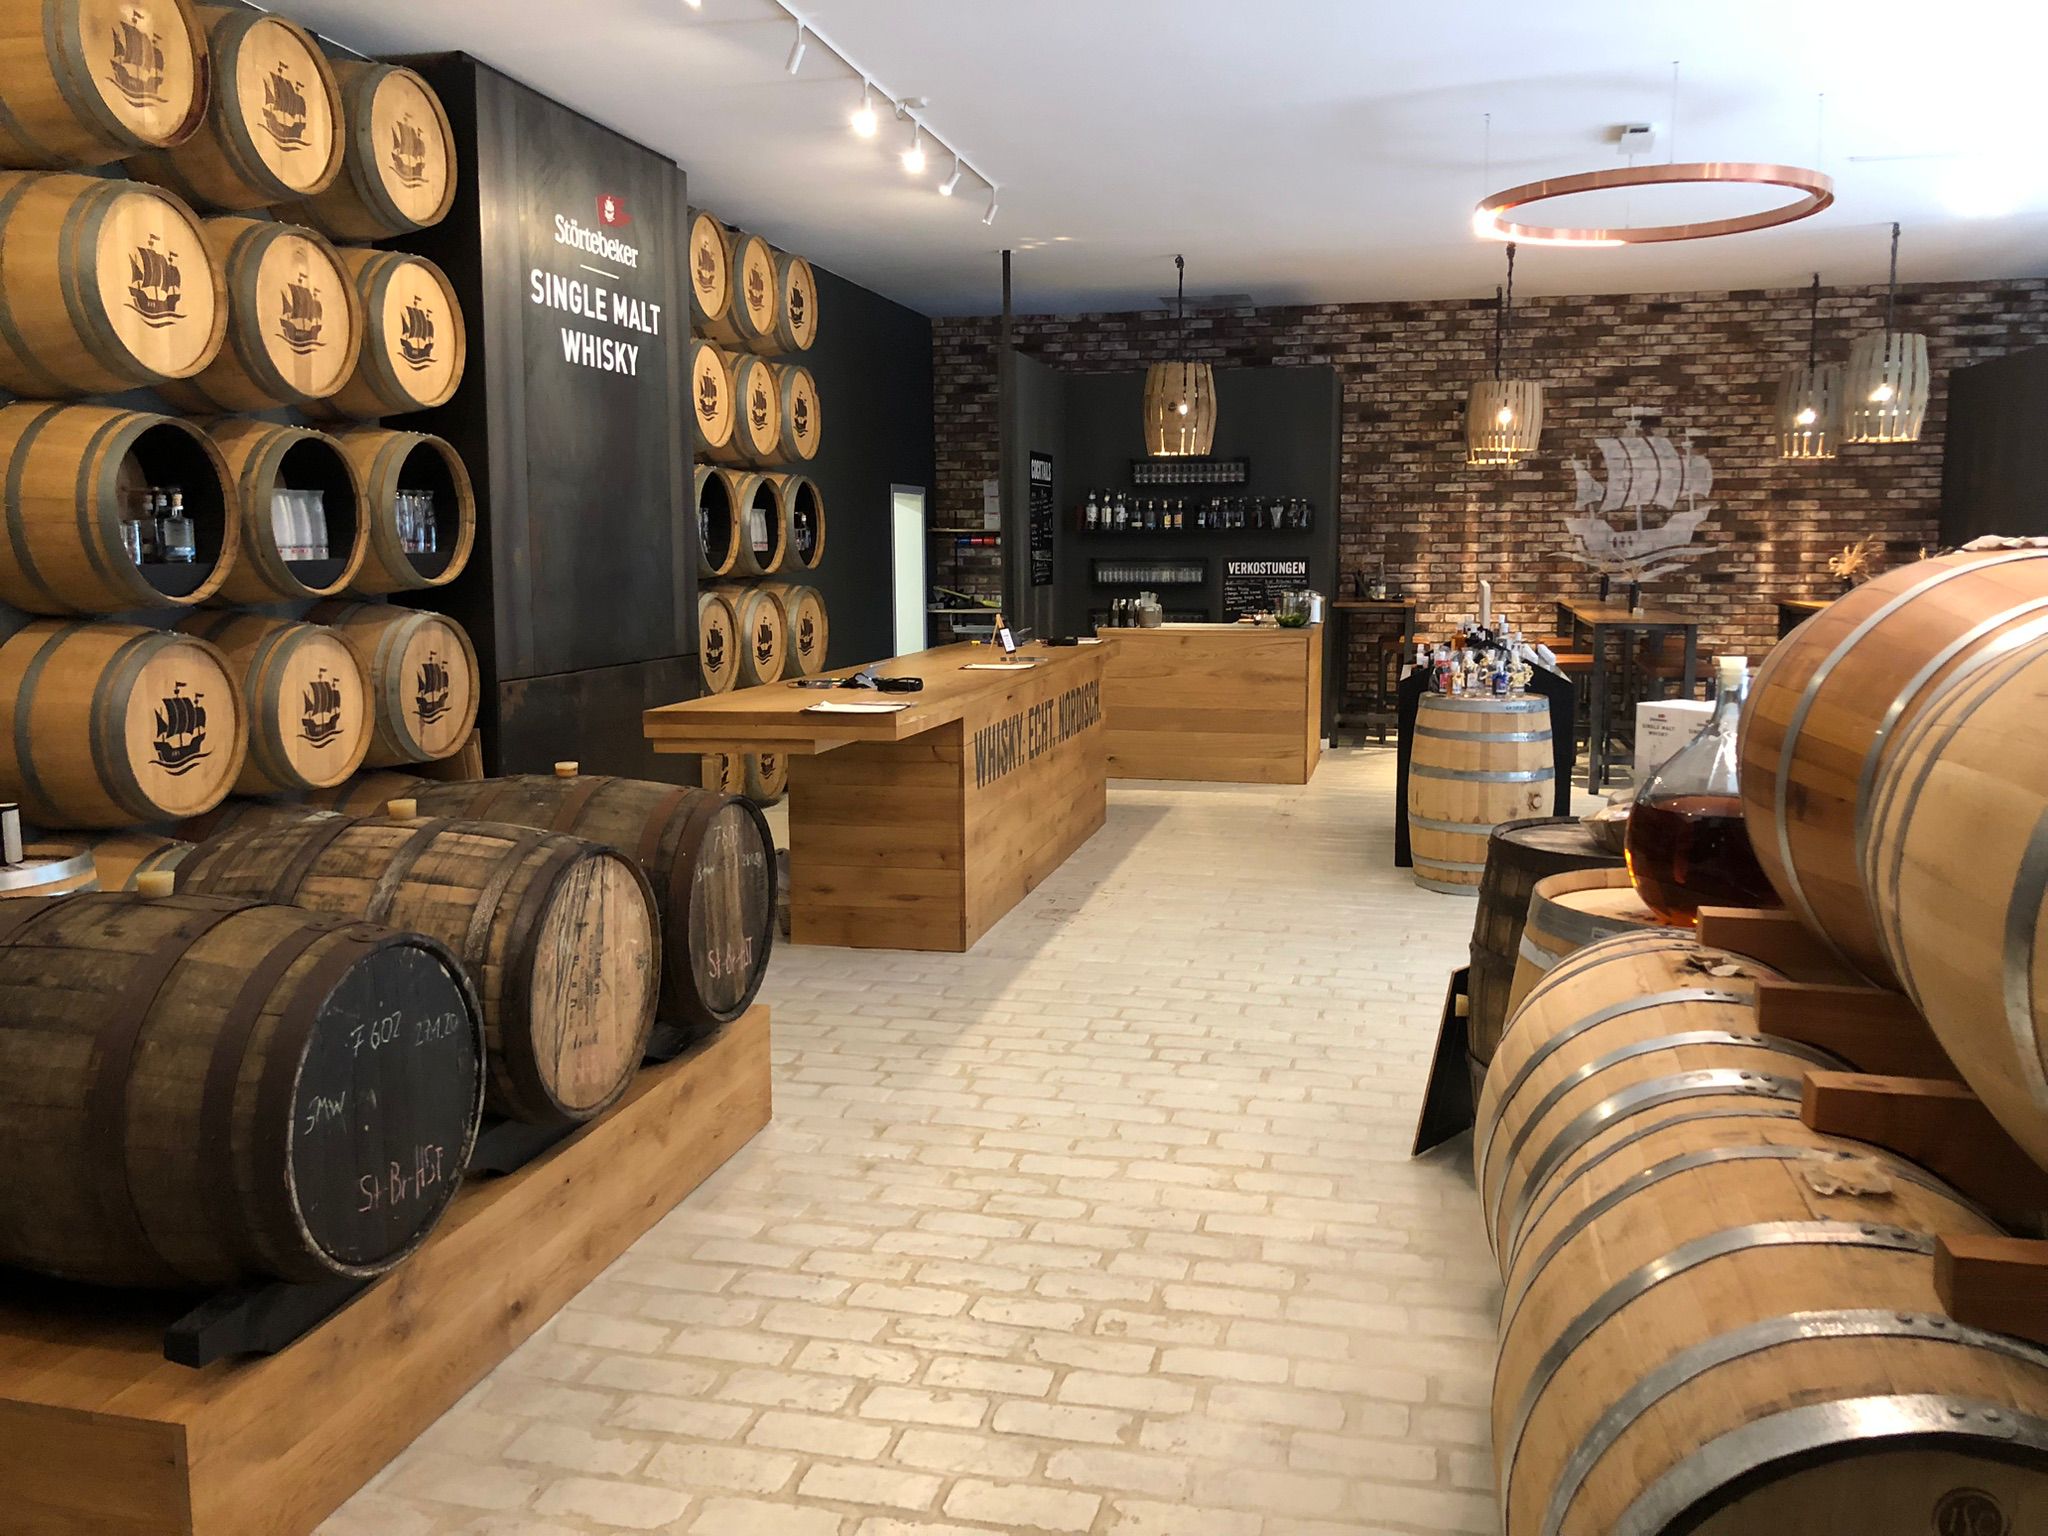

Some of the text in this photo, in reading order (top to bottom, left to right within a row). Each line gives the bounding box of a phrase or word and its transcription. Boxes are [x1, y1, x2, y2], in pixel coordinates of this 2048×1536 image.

[554, 213, 639, 268] Störtebeker
[530, 268, 661, 335] SINGLE MALT
[561, 327, 639, 376] WHISKY
[1031, 459, 1052, 481] COCKTAILS
[1228, 561, 1306, 575] VERKOSTUNGEN
[1028, 698, 1056, 760] ECHT.
[1058, 678, 1102, 740] NORDISCH.
